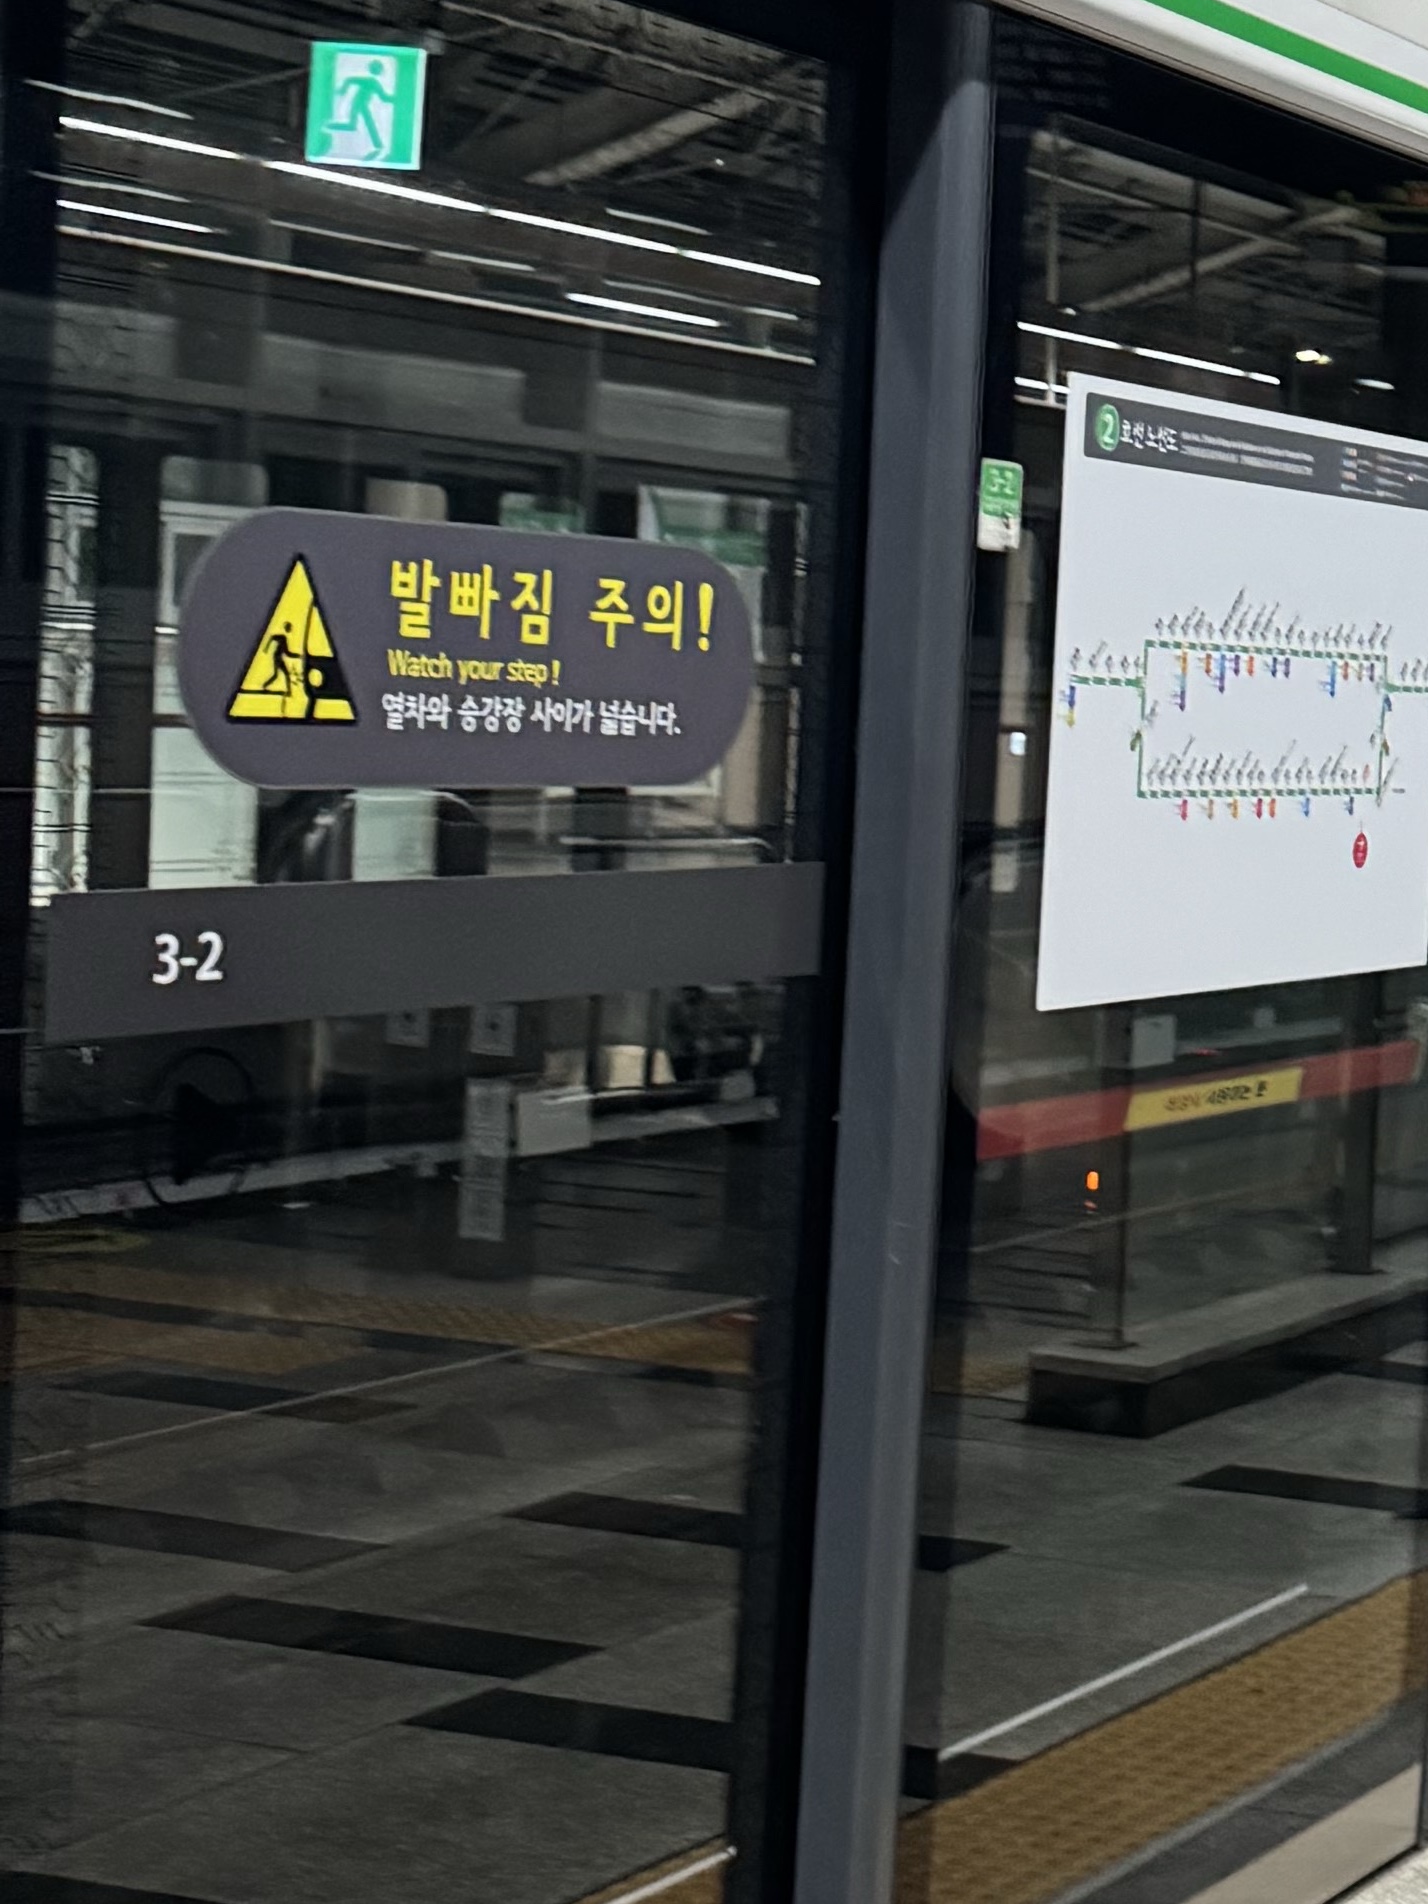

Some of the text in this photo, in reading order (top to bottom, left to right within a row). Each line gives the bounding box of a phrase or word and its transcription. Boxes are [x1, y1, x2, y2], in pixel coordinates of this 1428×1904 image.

[389, 559, 714, 652] 발빠짐 주의!
[387, 648, 452, 679] Watch
[456, 658, 504, 685] your
[381, 692, 452, 731] 열차와
[457, 695, 526, 733] 승강장
[530, 697, 594, 734] 사이가
[152, 930, 225, 985] 3-2
